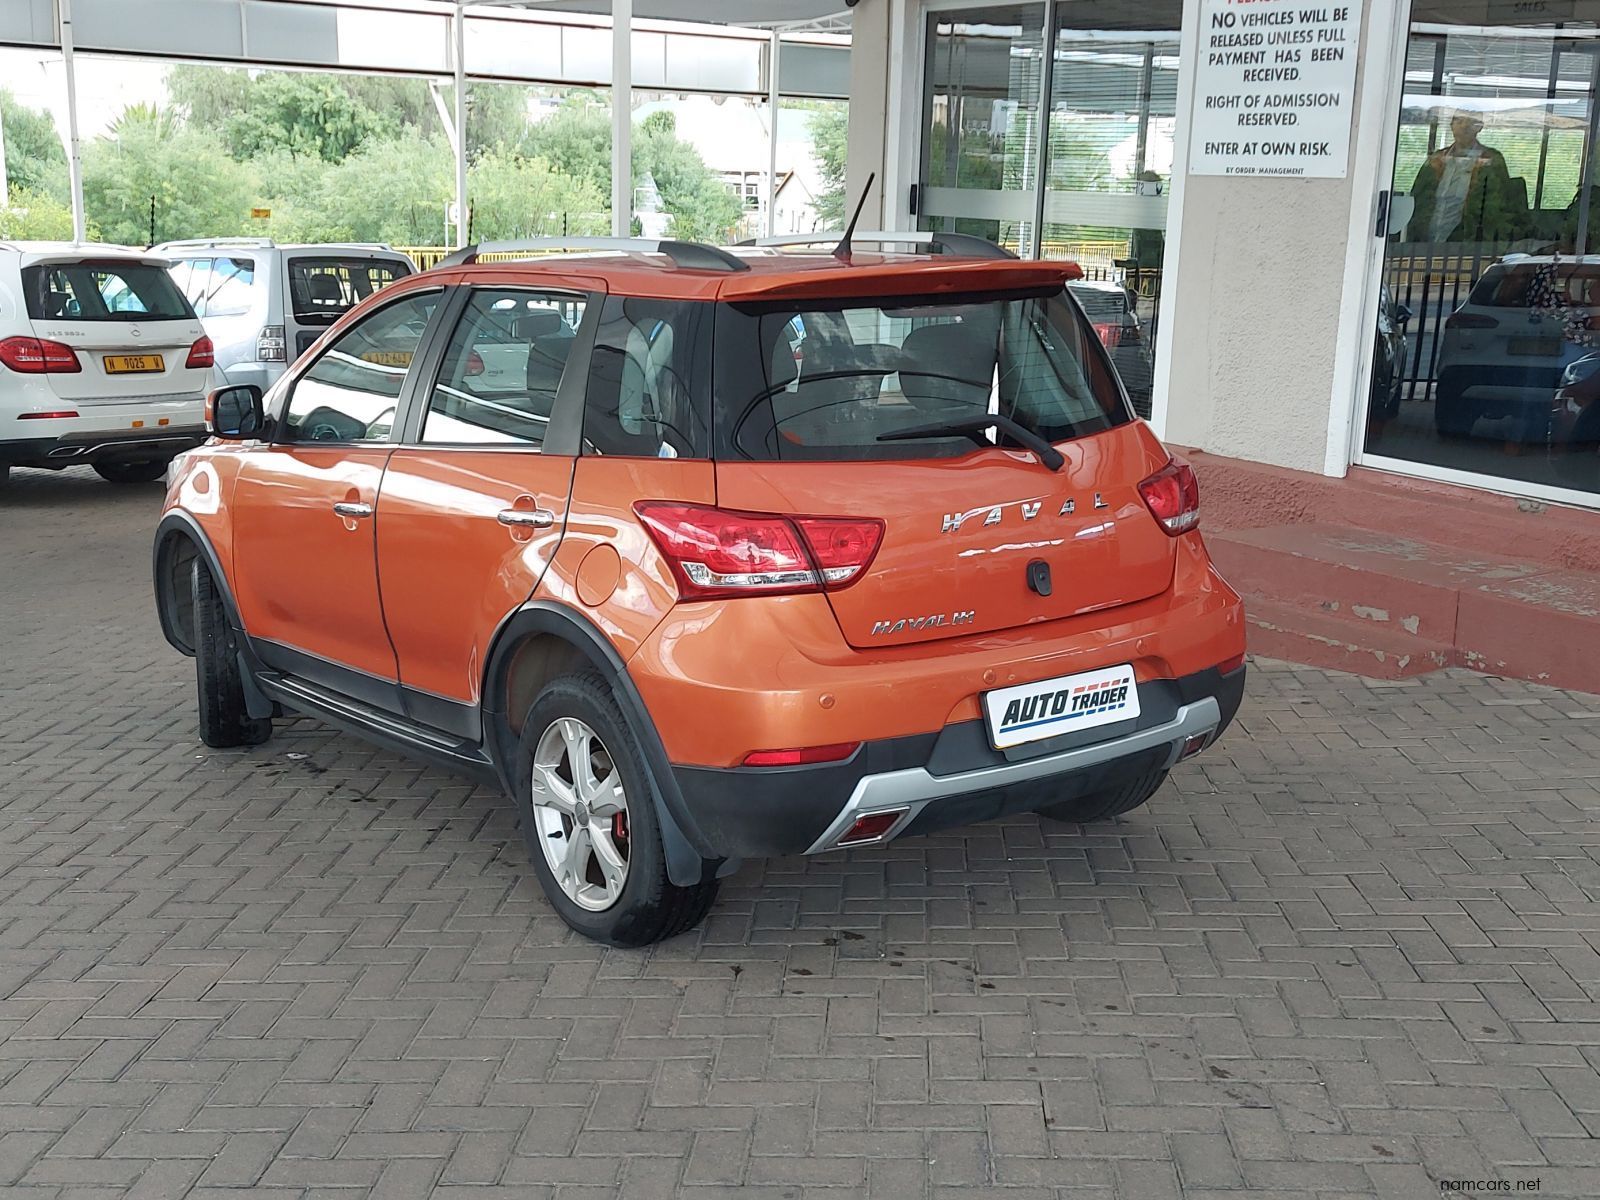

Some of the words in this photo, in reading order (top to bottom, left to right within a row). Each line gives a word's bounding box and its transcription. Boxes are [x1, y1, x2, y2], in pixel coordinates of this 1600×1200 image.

[1212, 12, 1236, 29] NO
[1241, 11, 1294, 27] VEHICLES
[1299, 9, 1328, 23] WILL
[1333, 7, 1349, 22] BE
[1210, 33, 1263, 48] RELEASED
[1267, 30, 1314, 45] UNLESS
[1317, 28, 1346, 43] FULL
[1209, 51, 1266, 66] PAYMENT
[1274, 49, 1301, 64] HAS
[1311, 47, 1344, 62] BEEN
[1243, 68, 1301, 82] RECEIVED.
[1205, 95, 1241, 109] RIGHT
[1244, 95, 1260, 108] OF
[1263, 93, 1340, 108] ADMISSION
[1238, 113, 1300, 126] RESERVED.
[1205, 142, 1239, 155] ENTER
[1242, 142, 1258, 155] AT
[1261, 142, 1295, 156] OWN
[1299, 142, 1332, 156] RISK.
[1226, 166, 1234, 174] BY
[1258, 167, 1304, 175] MANAGEMENT
[941, 492, 1109, 533] HAVAL
[871, 614, 950, 635] HAVAL
[1001, 689, 1069, 727] AUTO
[1072, 685, 1129, 712] TRADER
